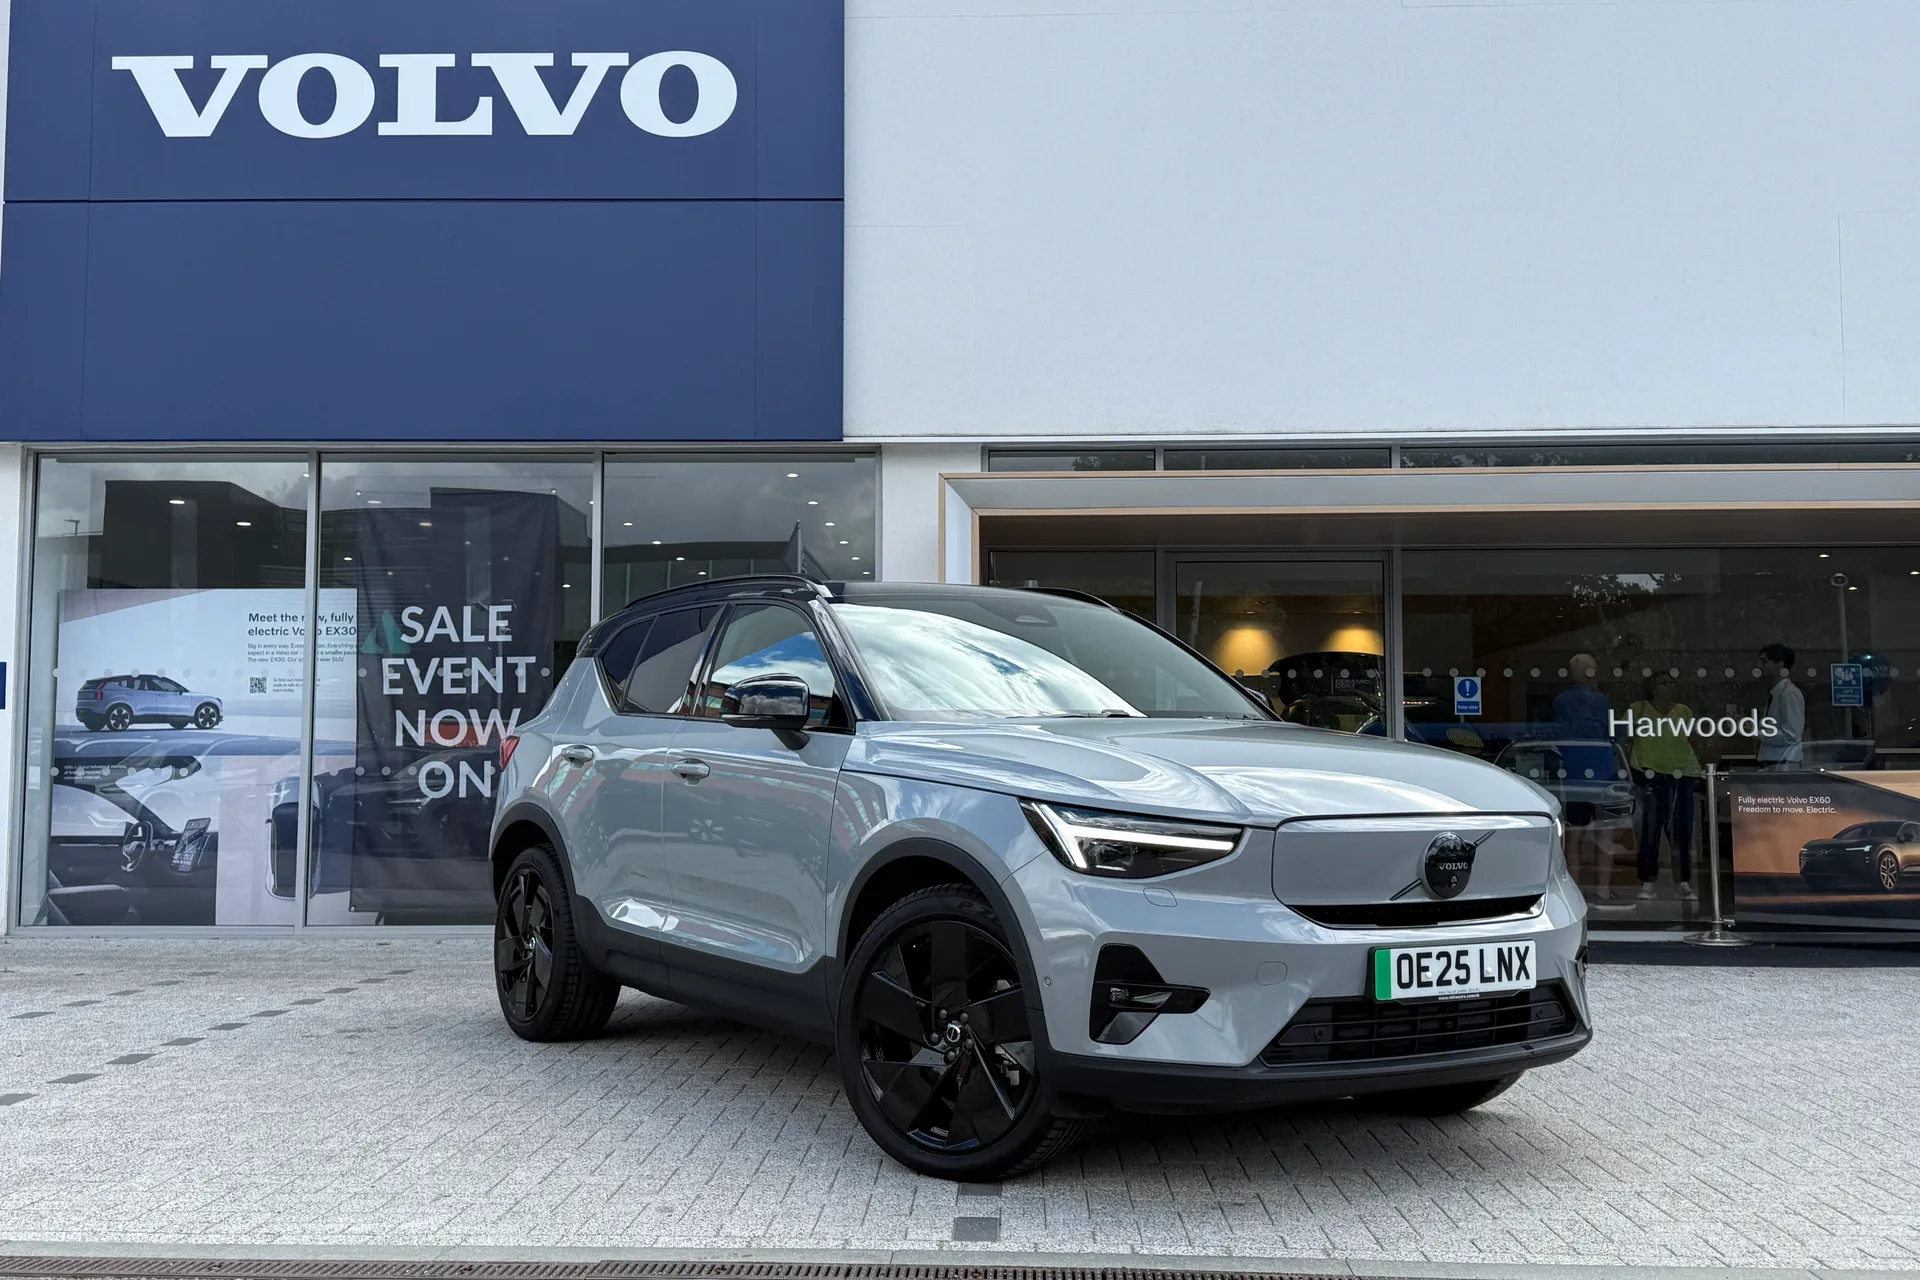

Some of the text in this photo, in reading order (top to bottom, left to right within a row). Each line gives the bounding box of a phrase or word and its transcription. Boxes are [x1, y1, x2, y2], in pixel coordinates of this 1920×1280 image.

[111, 50, 738, 139] VOLVO
[248, 612, 278, 622] Meet
[280, 612, 298, 622] the
[330, 612, 354, 624] fully
[248, 626, 289, 636] electric
[326, 626, 357, 636] EX30
[400, 604, 513, 644] SALE
[381, 655, 536, 695] EVENT
[395, 707, 521, 747] NOW
[1608, 708, 1778, 738] Harwoods
[418, 760, 492, 799] ON
[1738, 796, 1831, 805] Fully electric Volvo EX60
[1806, 806, 1837, 814] Electric.
[1438, 862, 1468, 870] VOLVO
[1396, 946, 1530, 990] OE25 LNX
